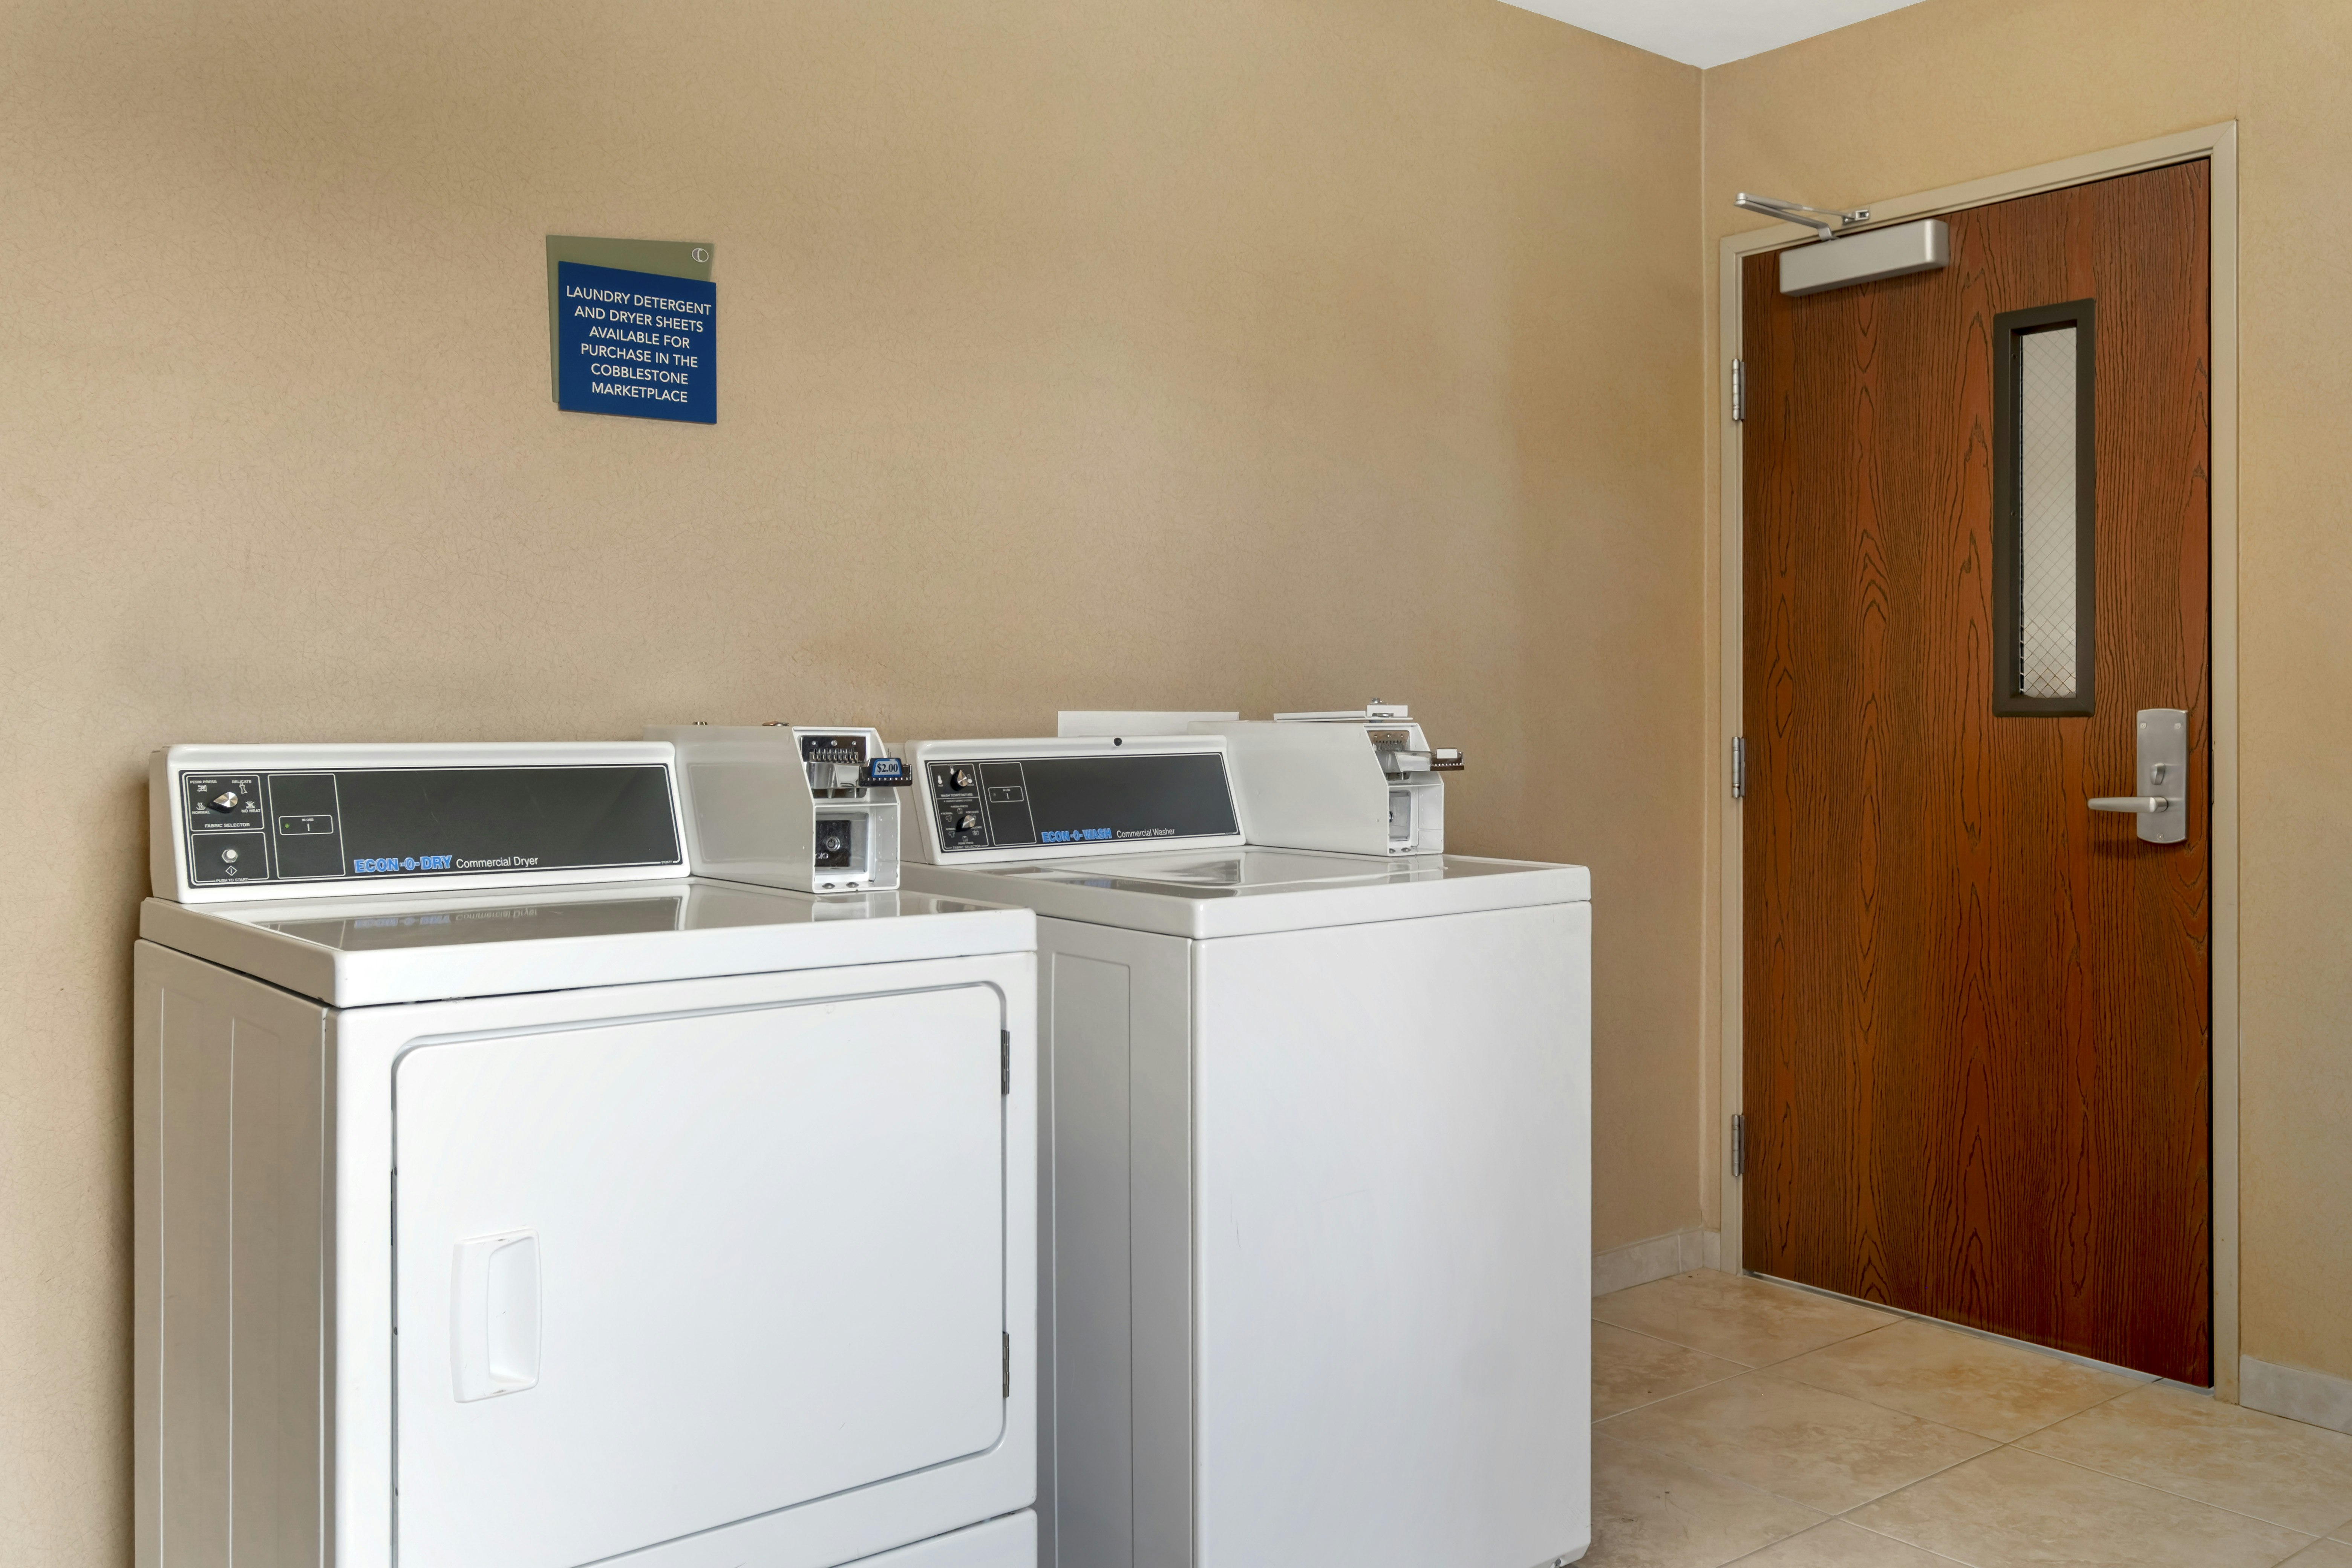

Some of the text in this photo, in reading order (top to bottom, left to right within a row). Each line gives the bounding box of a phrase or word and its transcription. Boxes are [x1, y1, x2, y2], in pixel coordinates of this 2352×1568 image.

[567, 285, 711, 315] LAUNDRY DETERGENT
[574, 305, 703, 332] AND DRYER SHEETS
[589, 326, 689, 349] AVAILABLE FOR
[581, 343, 698, 368] PURCHASE IN THE
[591, 363, 688, 384] COBBLESTONE
[592, 381, 688, 403] MARKETPLACE
[877, 763, 898, 773] $2.00
[1041, 828, 1112, 843] ECON-O-WASH
[1116, 829, 1152, 838] Commercial
[354, 855, 453, 873] ECON-O-DRY
[456, 856, 539, 868] Commercial Dryer
